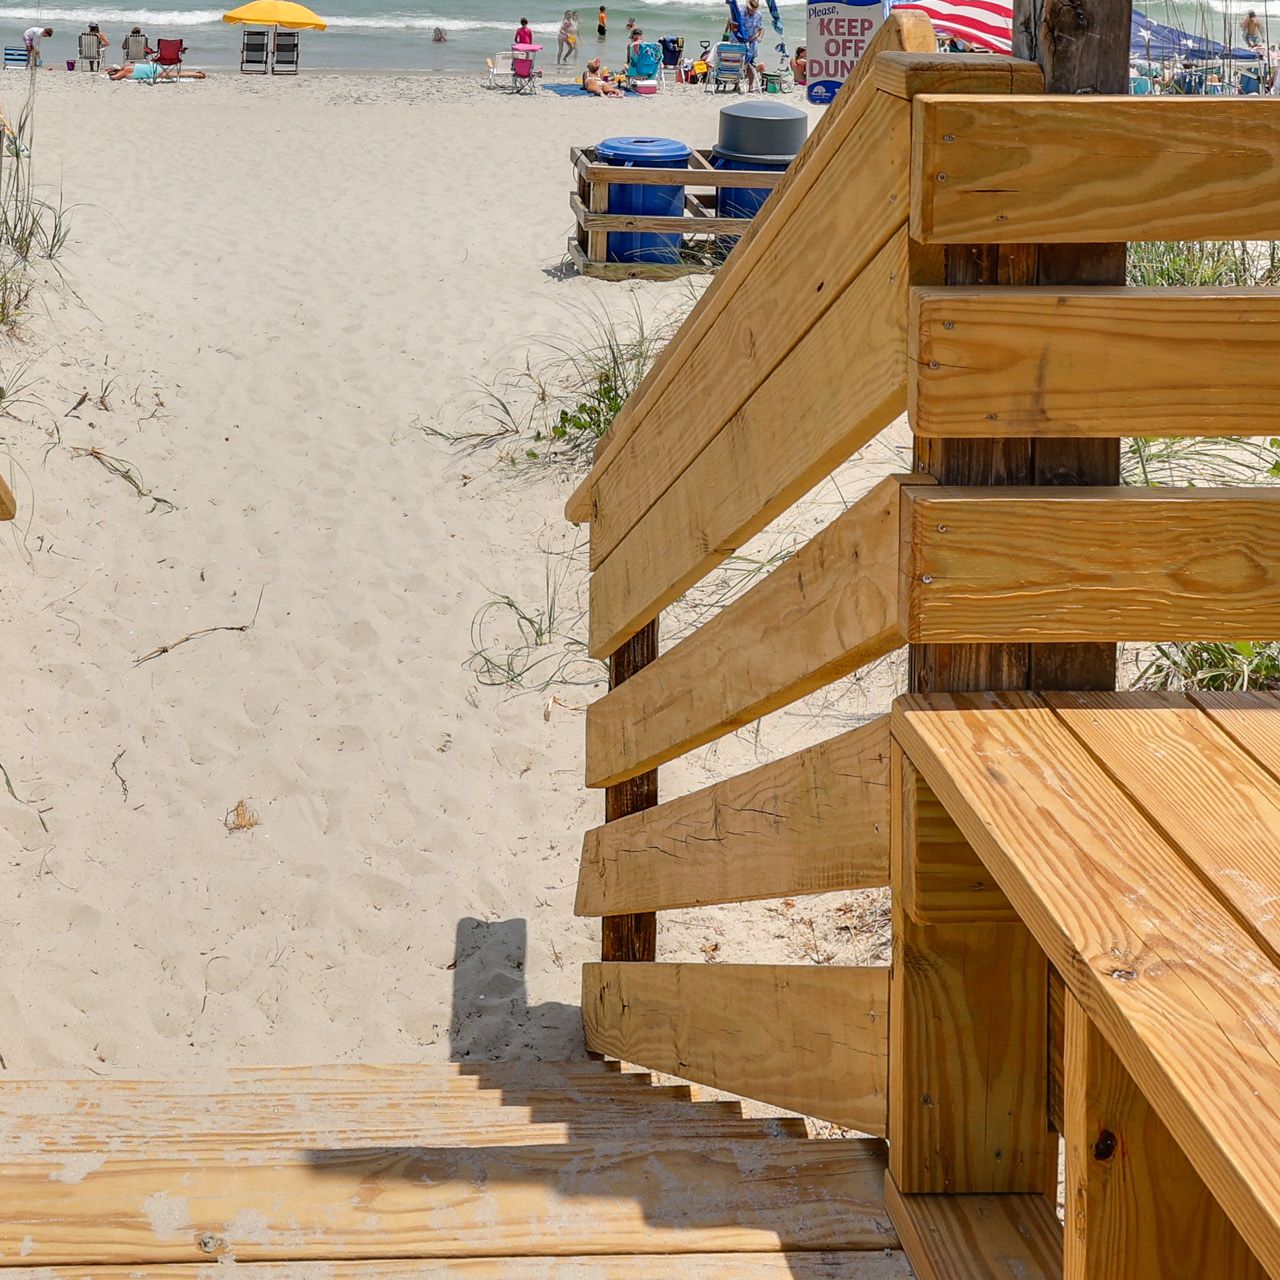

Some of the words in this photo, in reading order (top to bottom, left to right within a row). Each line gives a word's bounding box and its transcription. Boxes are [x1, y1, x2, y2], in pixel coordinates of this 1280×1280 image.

[808, 5, 840, 20] Please,
[819, 18, 874, 37] KEEP
[824, 39, 866, 58] OFF
[808, 59, 856, 78] DUN
